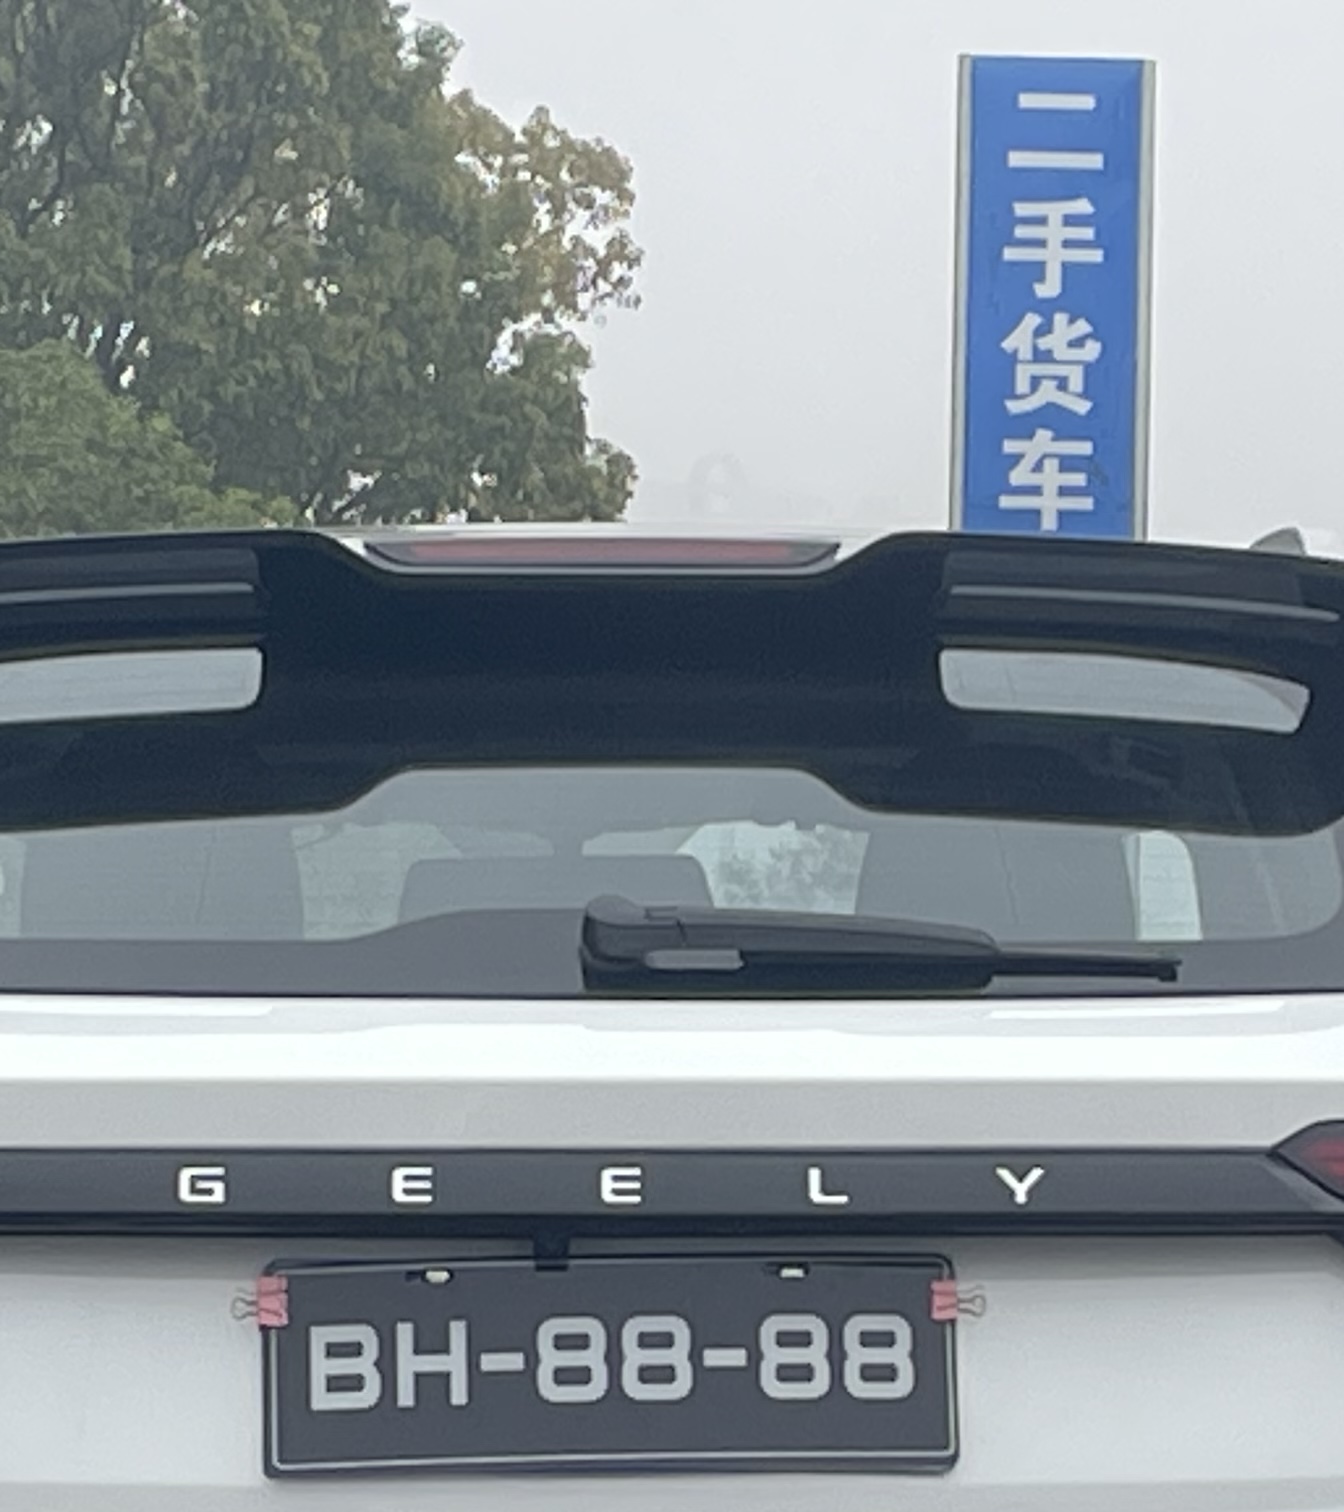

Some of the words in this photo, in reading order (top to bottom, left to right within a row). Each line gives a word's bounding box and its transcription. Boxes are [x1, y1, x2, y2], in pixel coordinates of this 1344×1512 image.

[998, 92, 1105, 532] 二手货车
[176, 1165, 1045, 1205] GEELY
[308, 1313, 916, 1412] BH-88-88
